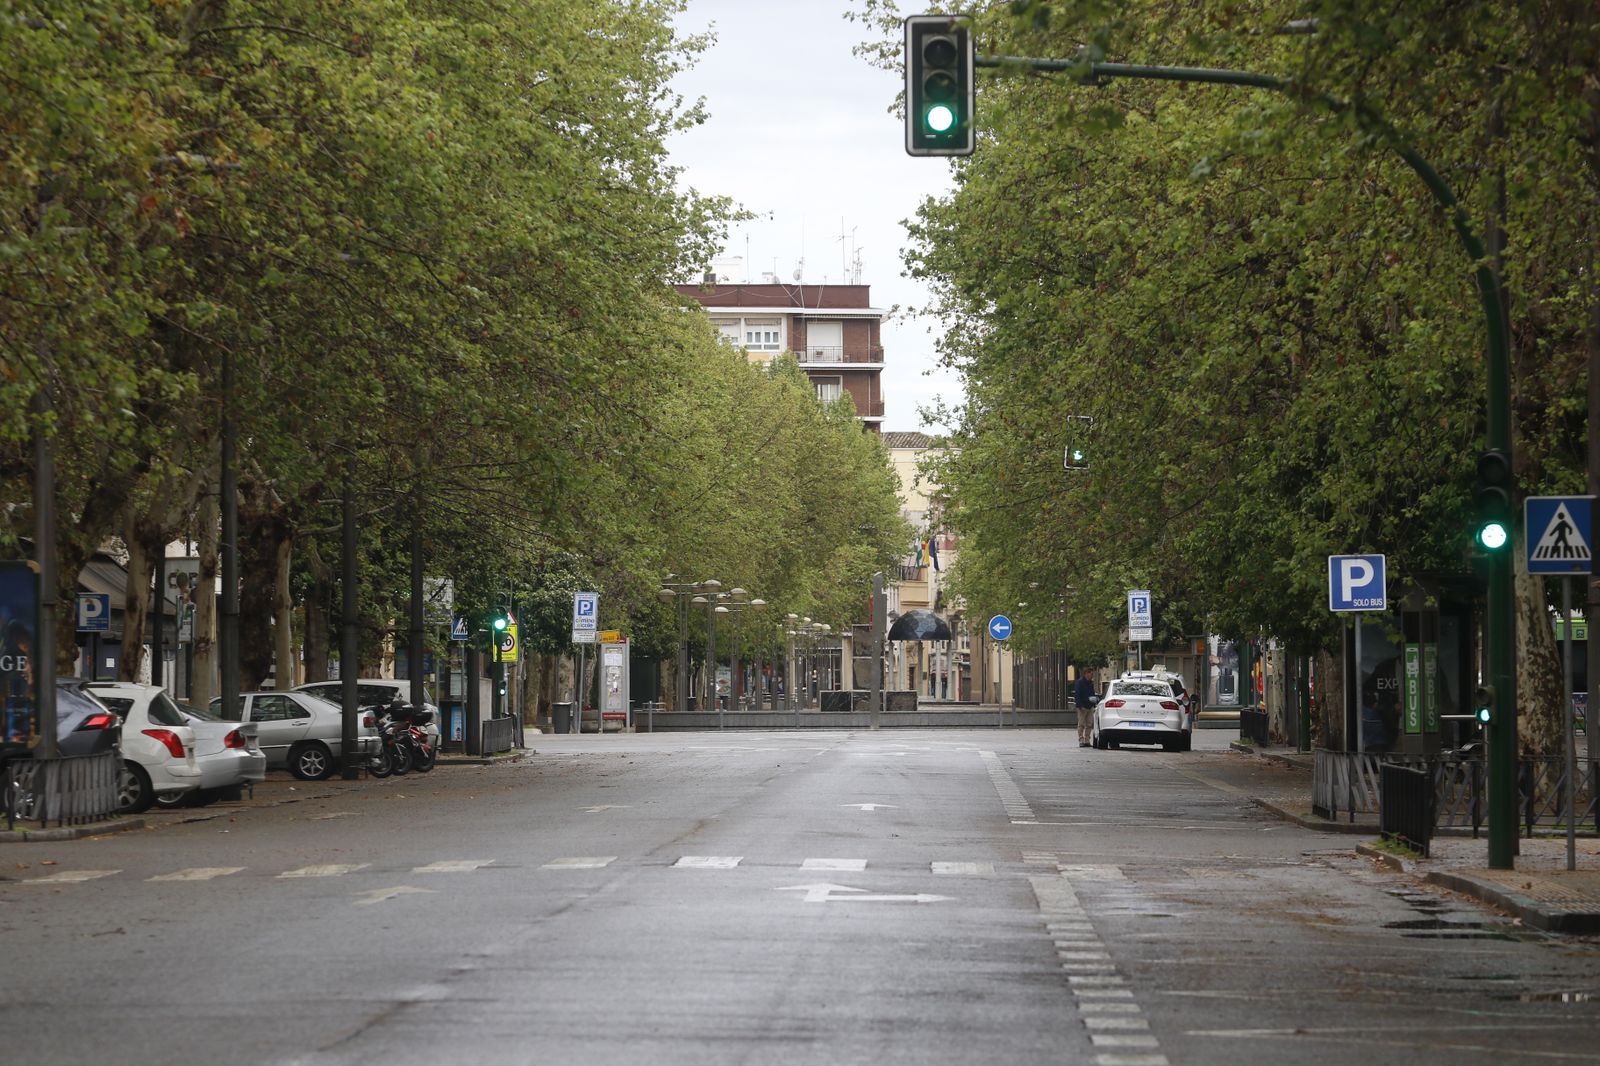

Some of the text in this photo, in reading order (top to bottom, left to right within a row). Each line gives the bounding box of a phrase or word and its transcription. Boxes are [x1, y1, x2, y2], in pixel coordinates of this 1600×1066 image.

[1341, 559, 1374, 602] P
[79, 597, 102, 627] P
[580, 601, 591, 615] P
[1134, 599, 1145, 613] P
[1353, 598, 1383, 607] SOLO BUS
[1409, 679, 1417, 726] BUS
[1427, 679, 1435, 726] BUS
